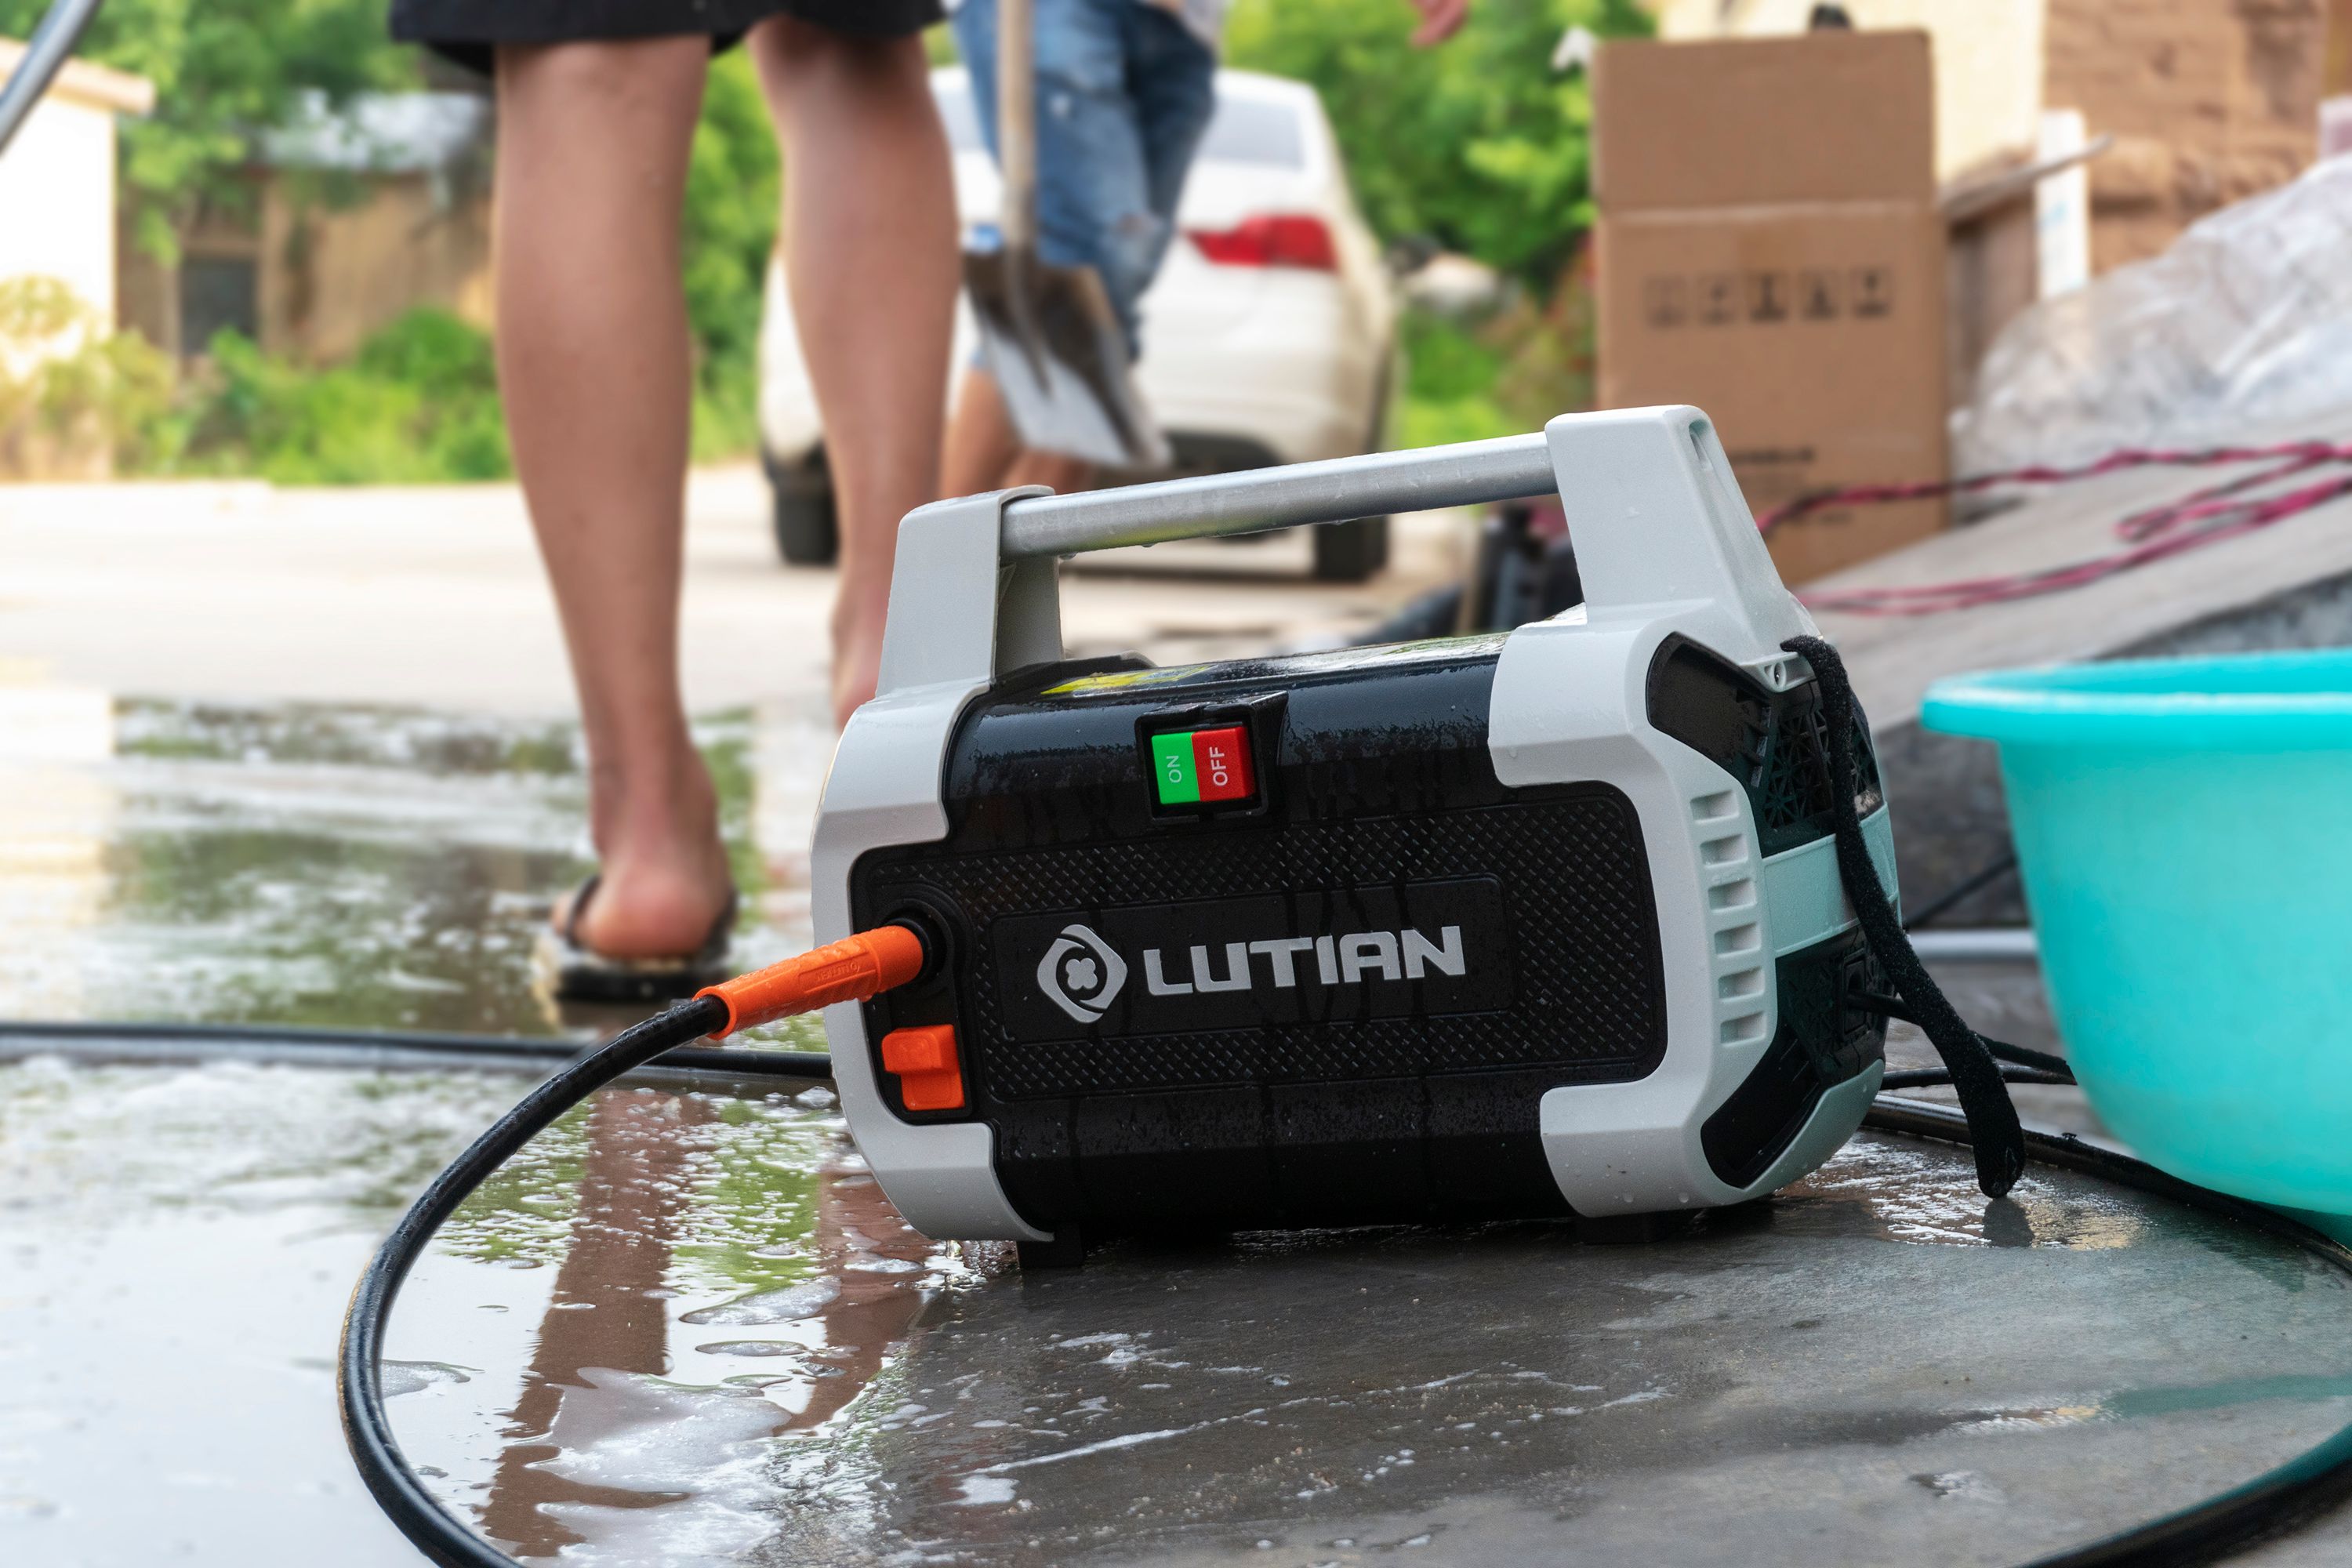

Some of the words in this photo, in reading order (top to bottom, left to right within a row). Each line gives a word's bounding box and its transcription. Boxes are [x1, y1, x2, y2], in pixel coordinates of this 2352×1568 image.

[1166, 755, 1182, 783] ON
[1209, 746, 1229, 786] OFF
[1143, 925, 1466, 996] LUTIAN
